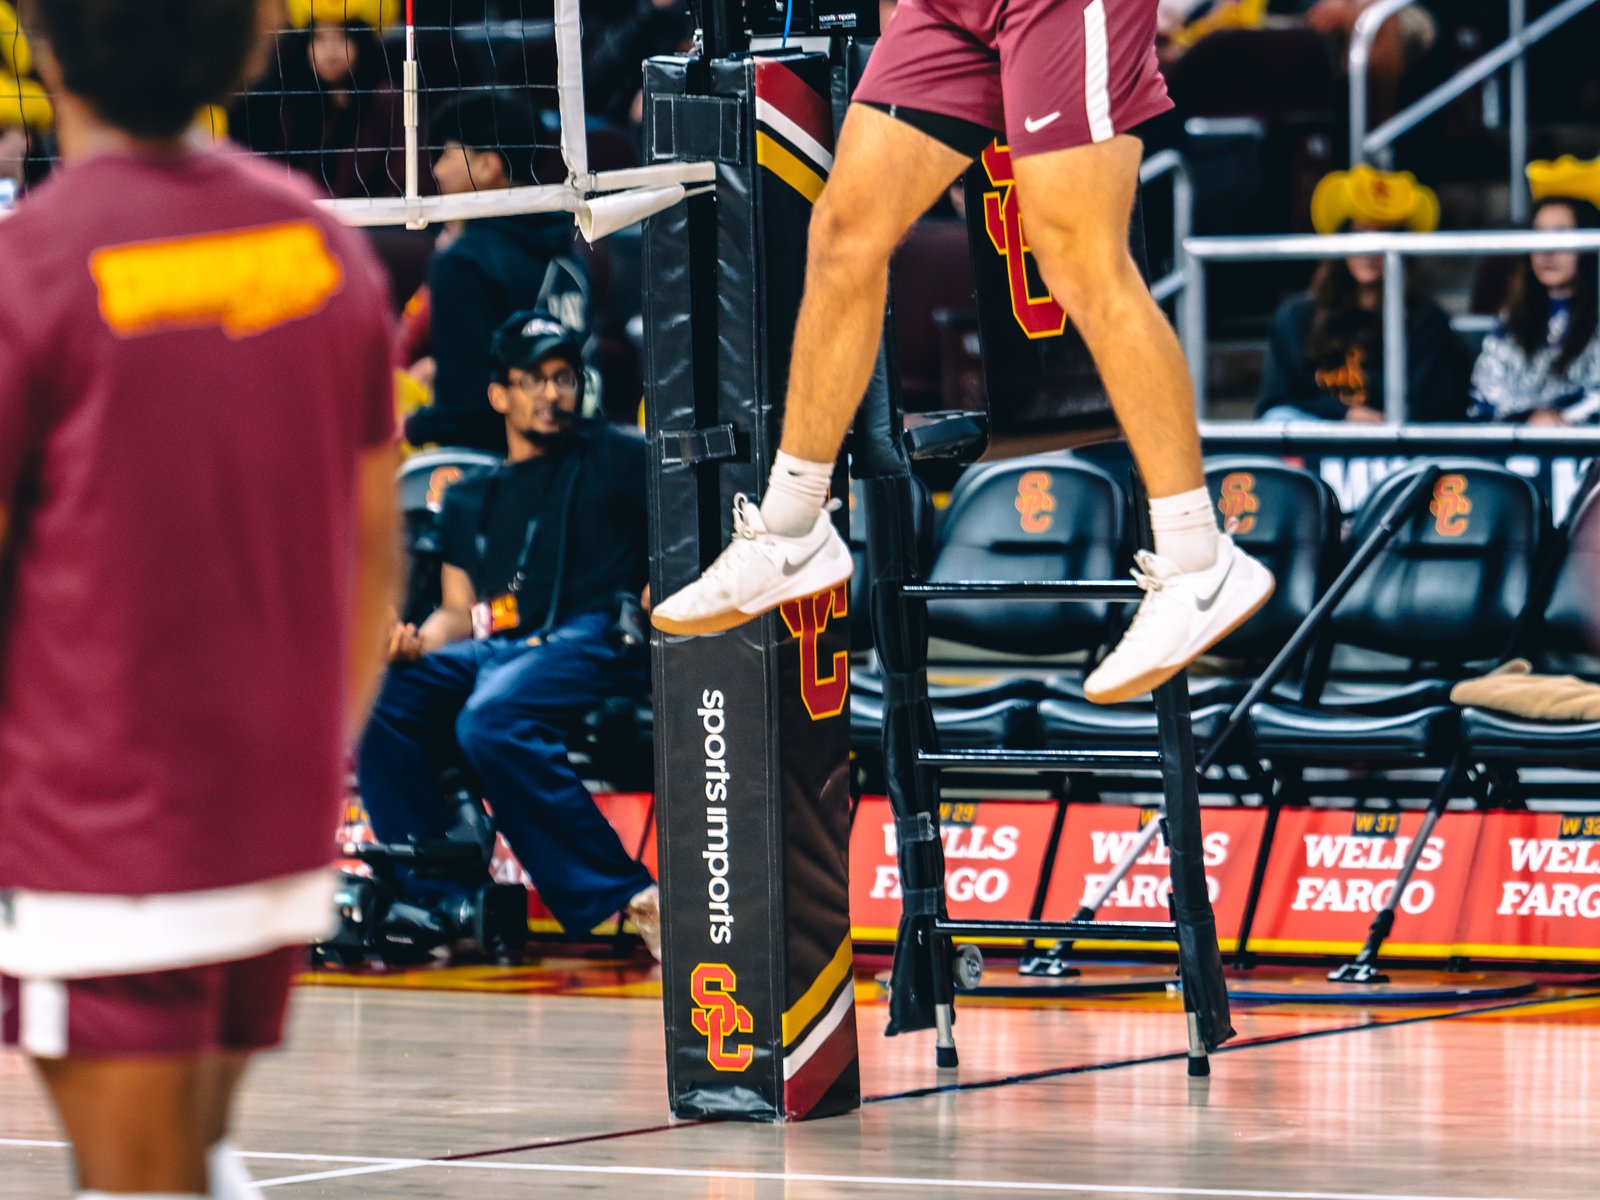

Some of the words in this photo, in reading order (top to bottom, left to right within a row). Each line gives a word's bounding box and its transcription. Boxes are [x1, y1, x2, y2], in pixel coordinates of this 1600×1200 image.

[697, 688, 731, 802] sports
[1356, 814, 1374, 833] W
[1375, 815, 1397, 833] 31
[1562, 817, 1581, 835] W
[1508, 838, 1600, 874] WEL
[691, 963, 754, 1072] SC
